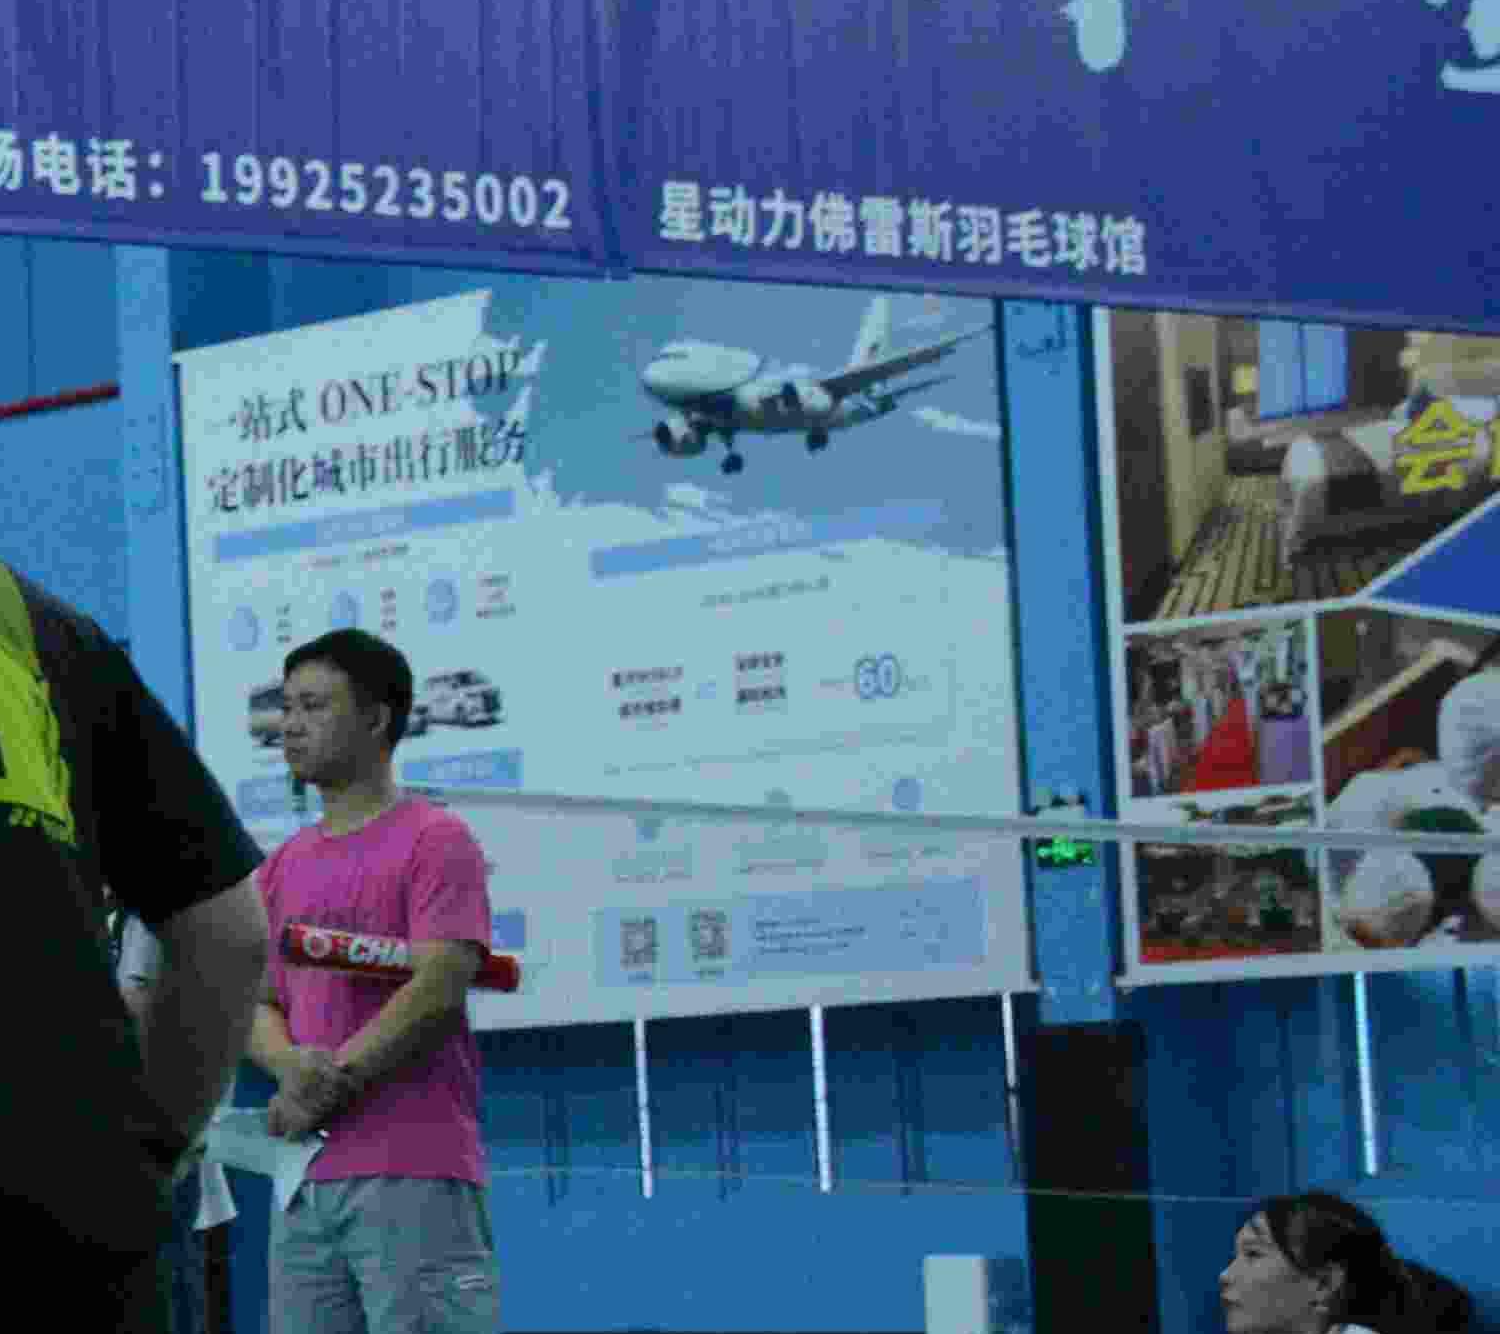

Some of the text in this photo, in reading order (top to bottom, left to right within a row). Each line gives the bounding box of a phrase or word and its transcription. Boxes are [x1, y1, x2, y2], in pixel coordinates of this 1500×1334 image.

[660, 180, 1147, 275] 星动力佛雷斯羽毛球馆
[320, 349, 522, 422] ONE-STOP
[1394, 400, 1500, 496] 会
